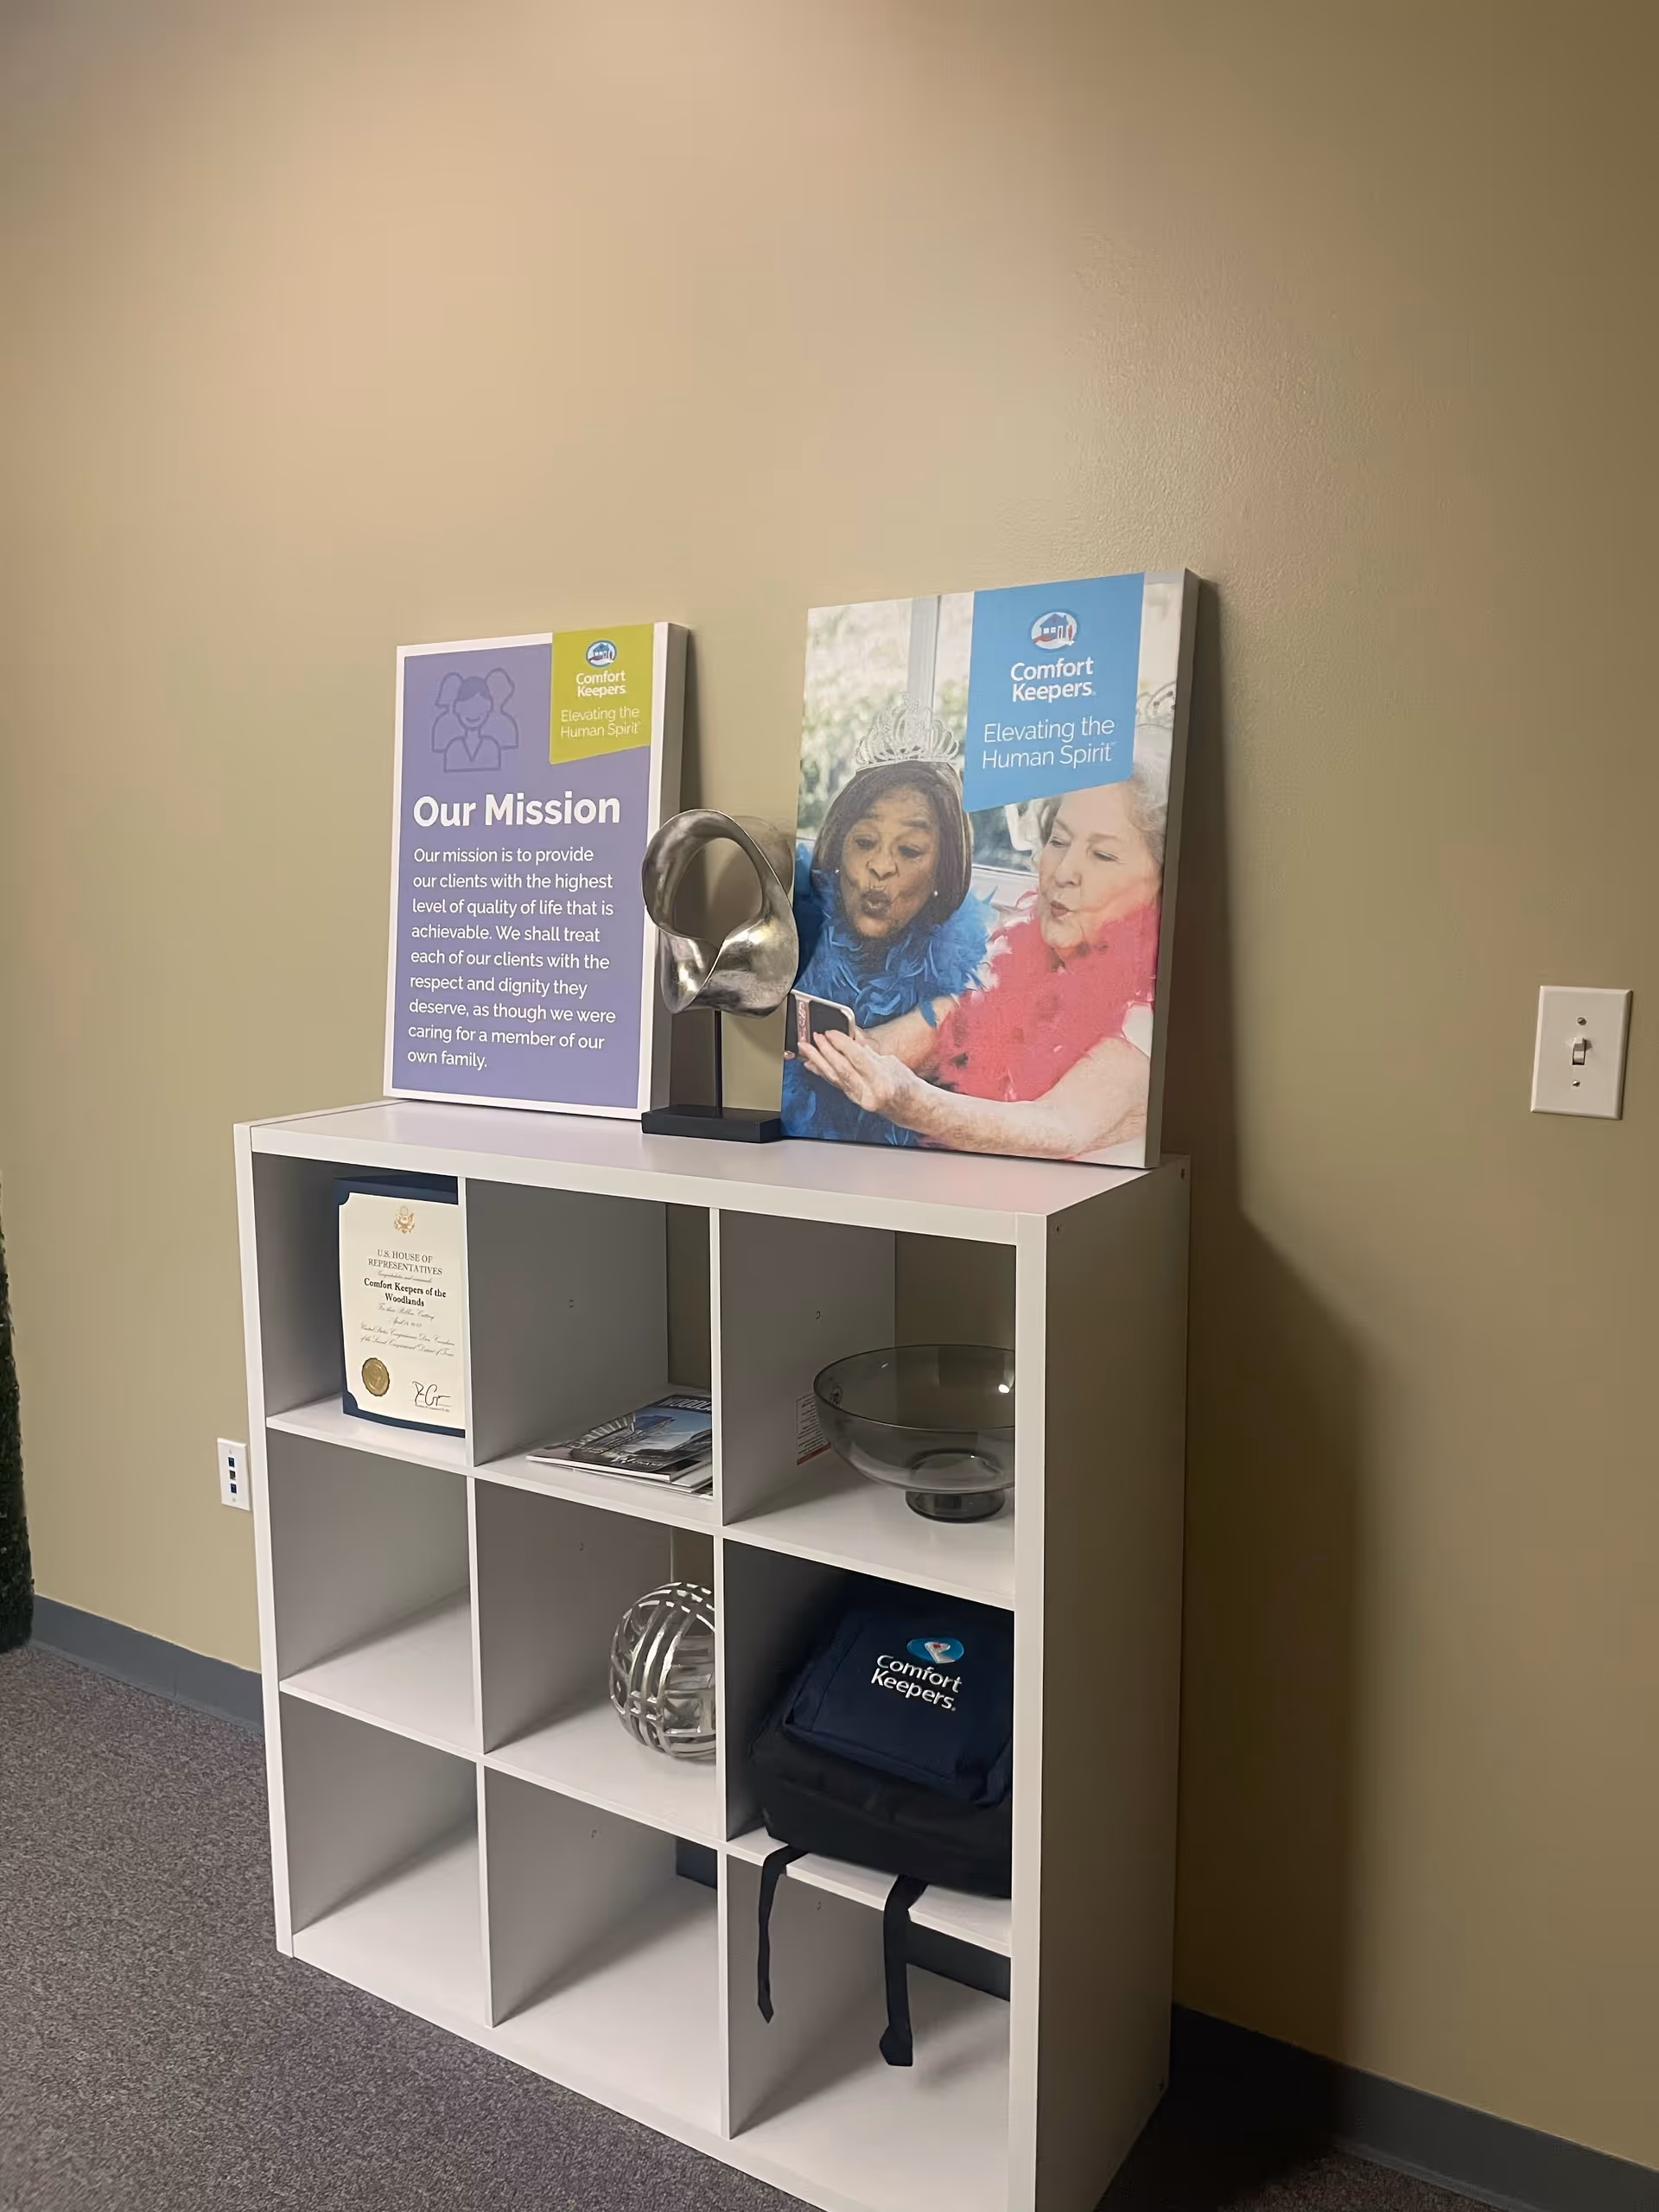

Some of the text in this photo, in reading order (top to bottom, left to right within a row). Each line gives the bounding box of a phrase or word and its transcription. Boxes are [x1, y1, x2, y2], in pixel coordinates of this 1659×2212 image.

[576, 671, 626, 684] Comfort
[1010, 657, 1094, 681] Comfort
[561, 705, 639, 723] Elevating the
[561, 724, 604, 739] Human
[984, 716, 1115, 743] Elevating the
[982, 742, 1111, 769] Human Spirit
[413, 791, 620, 827] Our Mission
[414, 847, 594, 866] Our mission is to provide
[413, 874, 613, 892] our clients with the highest
[413, 899, 613, 918] level of quality of life that is
[411, 925, 600, 943] achievable. We shall treat
[411, 950, 610, 969] each of our clients with the
[410, 976, 588, 999] respect and dignity they
[409, 1000, 616, 1023] deserve, as though we were
[408, 1027, 604, 1049] caring for a member of our
[408, 1050, 487, 1071] own family.
[368, 1258, 442, 1274] REPRESENTATIVES
[392, 1251, 420, 1262] HOUSE
[364, 1278, 392, 1289] Comfort
[394, 1282, 423, 1294] Keepers
[425, 1287, 433, 1296] of
[385, 1293, 424, 1306] Woodlands
[877, 1655, 962, 1694] Comfort
